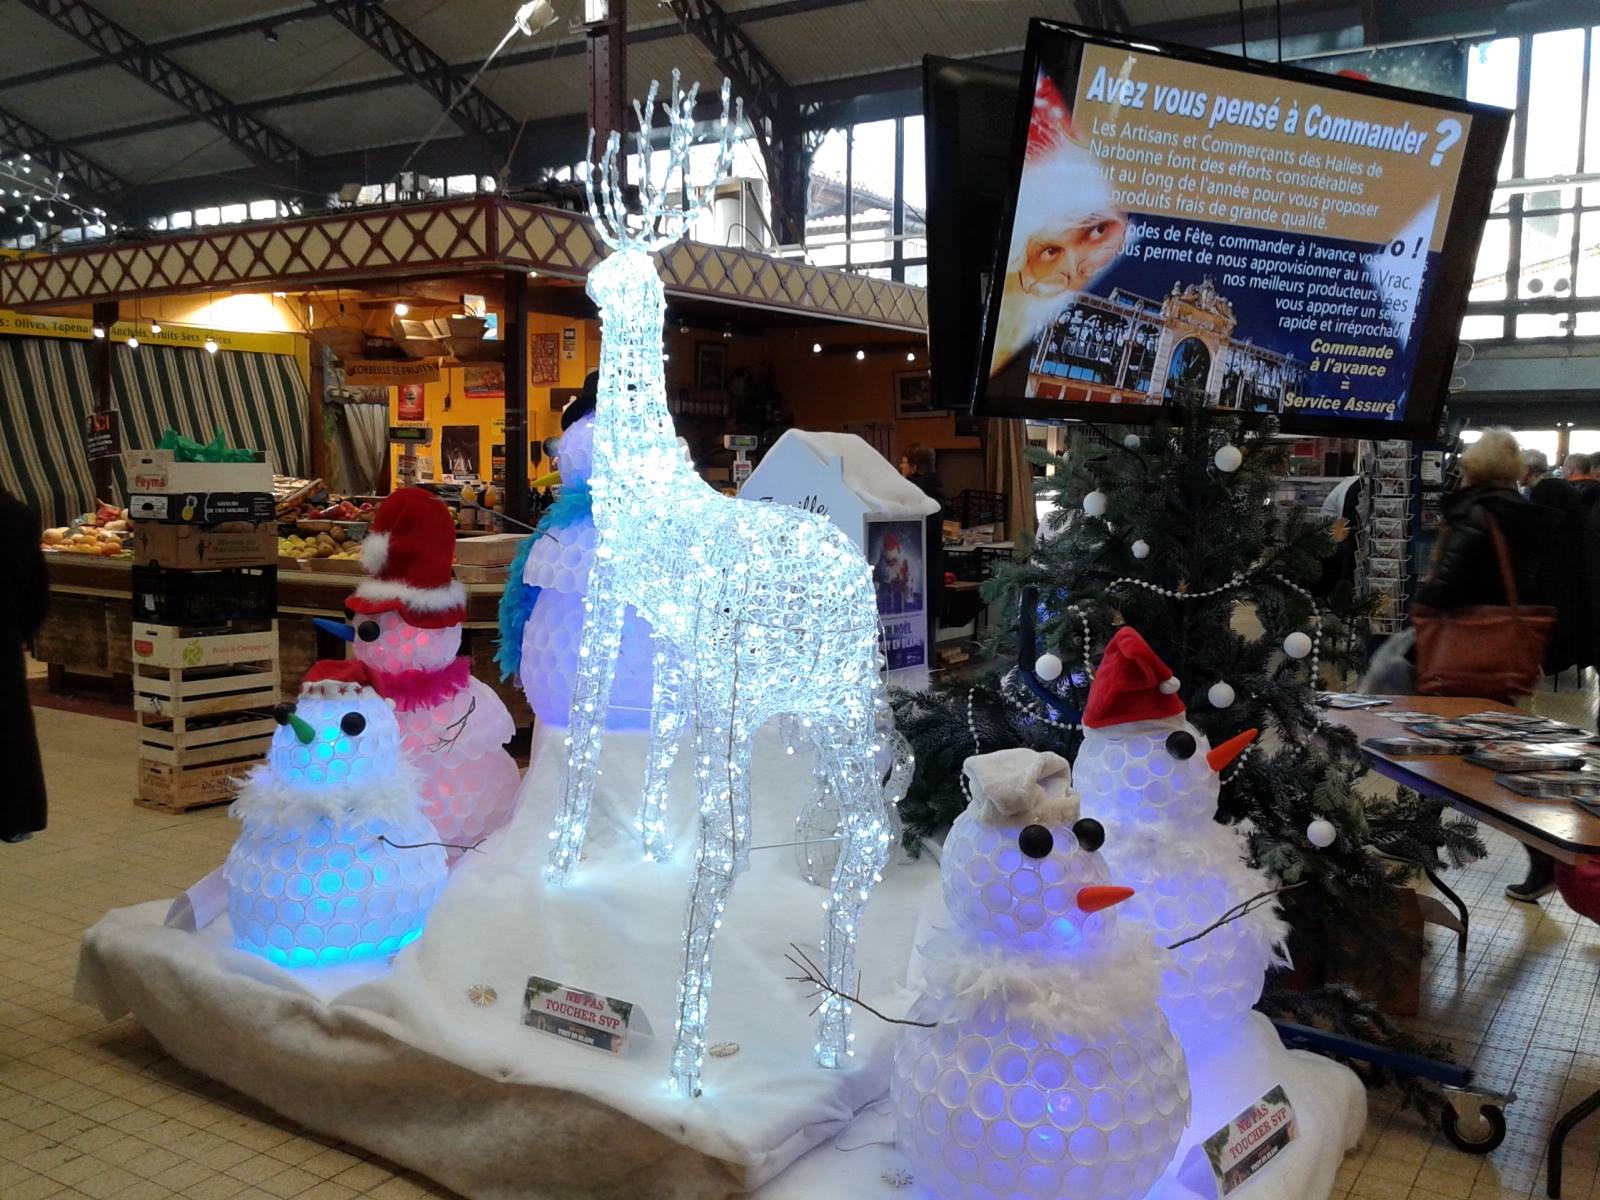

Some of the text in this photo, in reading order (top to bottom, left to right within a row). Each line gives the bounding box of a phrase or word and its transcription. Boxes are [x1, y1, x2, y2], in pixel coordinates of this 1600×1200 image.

[1086, 65, 1463, 168] Avez vous pensé à Commander ?
[1092, 116, 1383, 178] Les Artisans et Commerçants des Halles de
[1088, 138, 1364, 195] Narbonne font des efforts considérables
[1119, 168, 1137, 184] au
[1141, 168, 1174, 193] long
[1178, 173, 1197, 192] de
[1199, 175, 1249, 200] l'année
[1252, 187, 1285, 205] pour
[1288, 192, 1319, 209] vous
[1321, 197, 1380, 217] proposer
[1112, 189, 1328, 230] produits frais de grande qualité.
[1164, 225, 1181, 242] de
[1184, 226, 1215, 248] Fête,
[1219, 234, 1295, 255] commander
[1297, 240, 1305, 257] à
[1308, 241, 1356, 263] l'avance
[1144, 245, 1193, 263] permet
[1195, 248, 1213, 265] de
[1216, 253, 1248, 269] nous
[1250, 257, 1342, 279] approvisionner
[1343, 268, 1359, 282] au
[1223, 273, 1378, 302] nos meilleurs producteurs
[1378, 269, 1413, 291] Vrac.
[1275, 297, 1304, 312] vous
[1306, 300, 1359, 318] apporter
[1360, 306, 1376, 320] un
[53, 321, 93, 334] Tapena
[1278, 315, 1318, 333] rapide
[1320, 319, 1333, 332] et
[1310, 338, 1394, 360] Commande
[353, 365, 392, 376] CORBEILLE
[402, 362, 434, 377] FRUITS
[1310, 357, 1387, 378] à l'avance
[1284, 391, 1396, 414] Service Assuré
[545, 998, 597, 1024] TOUCHER
[597, 1015, 621, 1029] SVP
[565, 991, 605, 1011] NE PAS
[1229, 1121, 1272, 1159] TOUCHER
[1271, 1107, 1288, 1127] SVP
[1237, 1104, 1269, 1134] NE PAS
